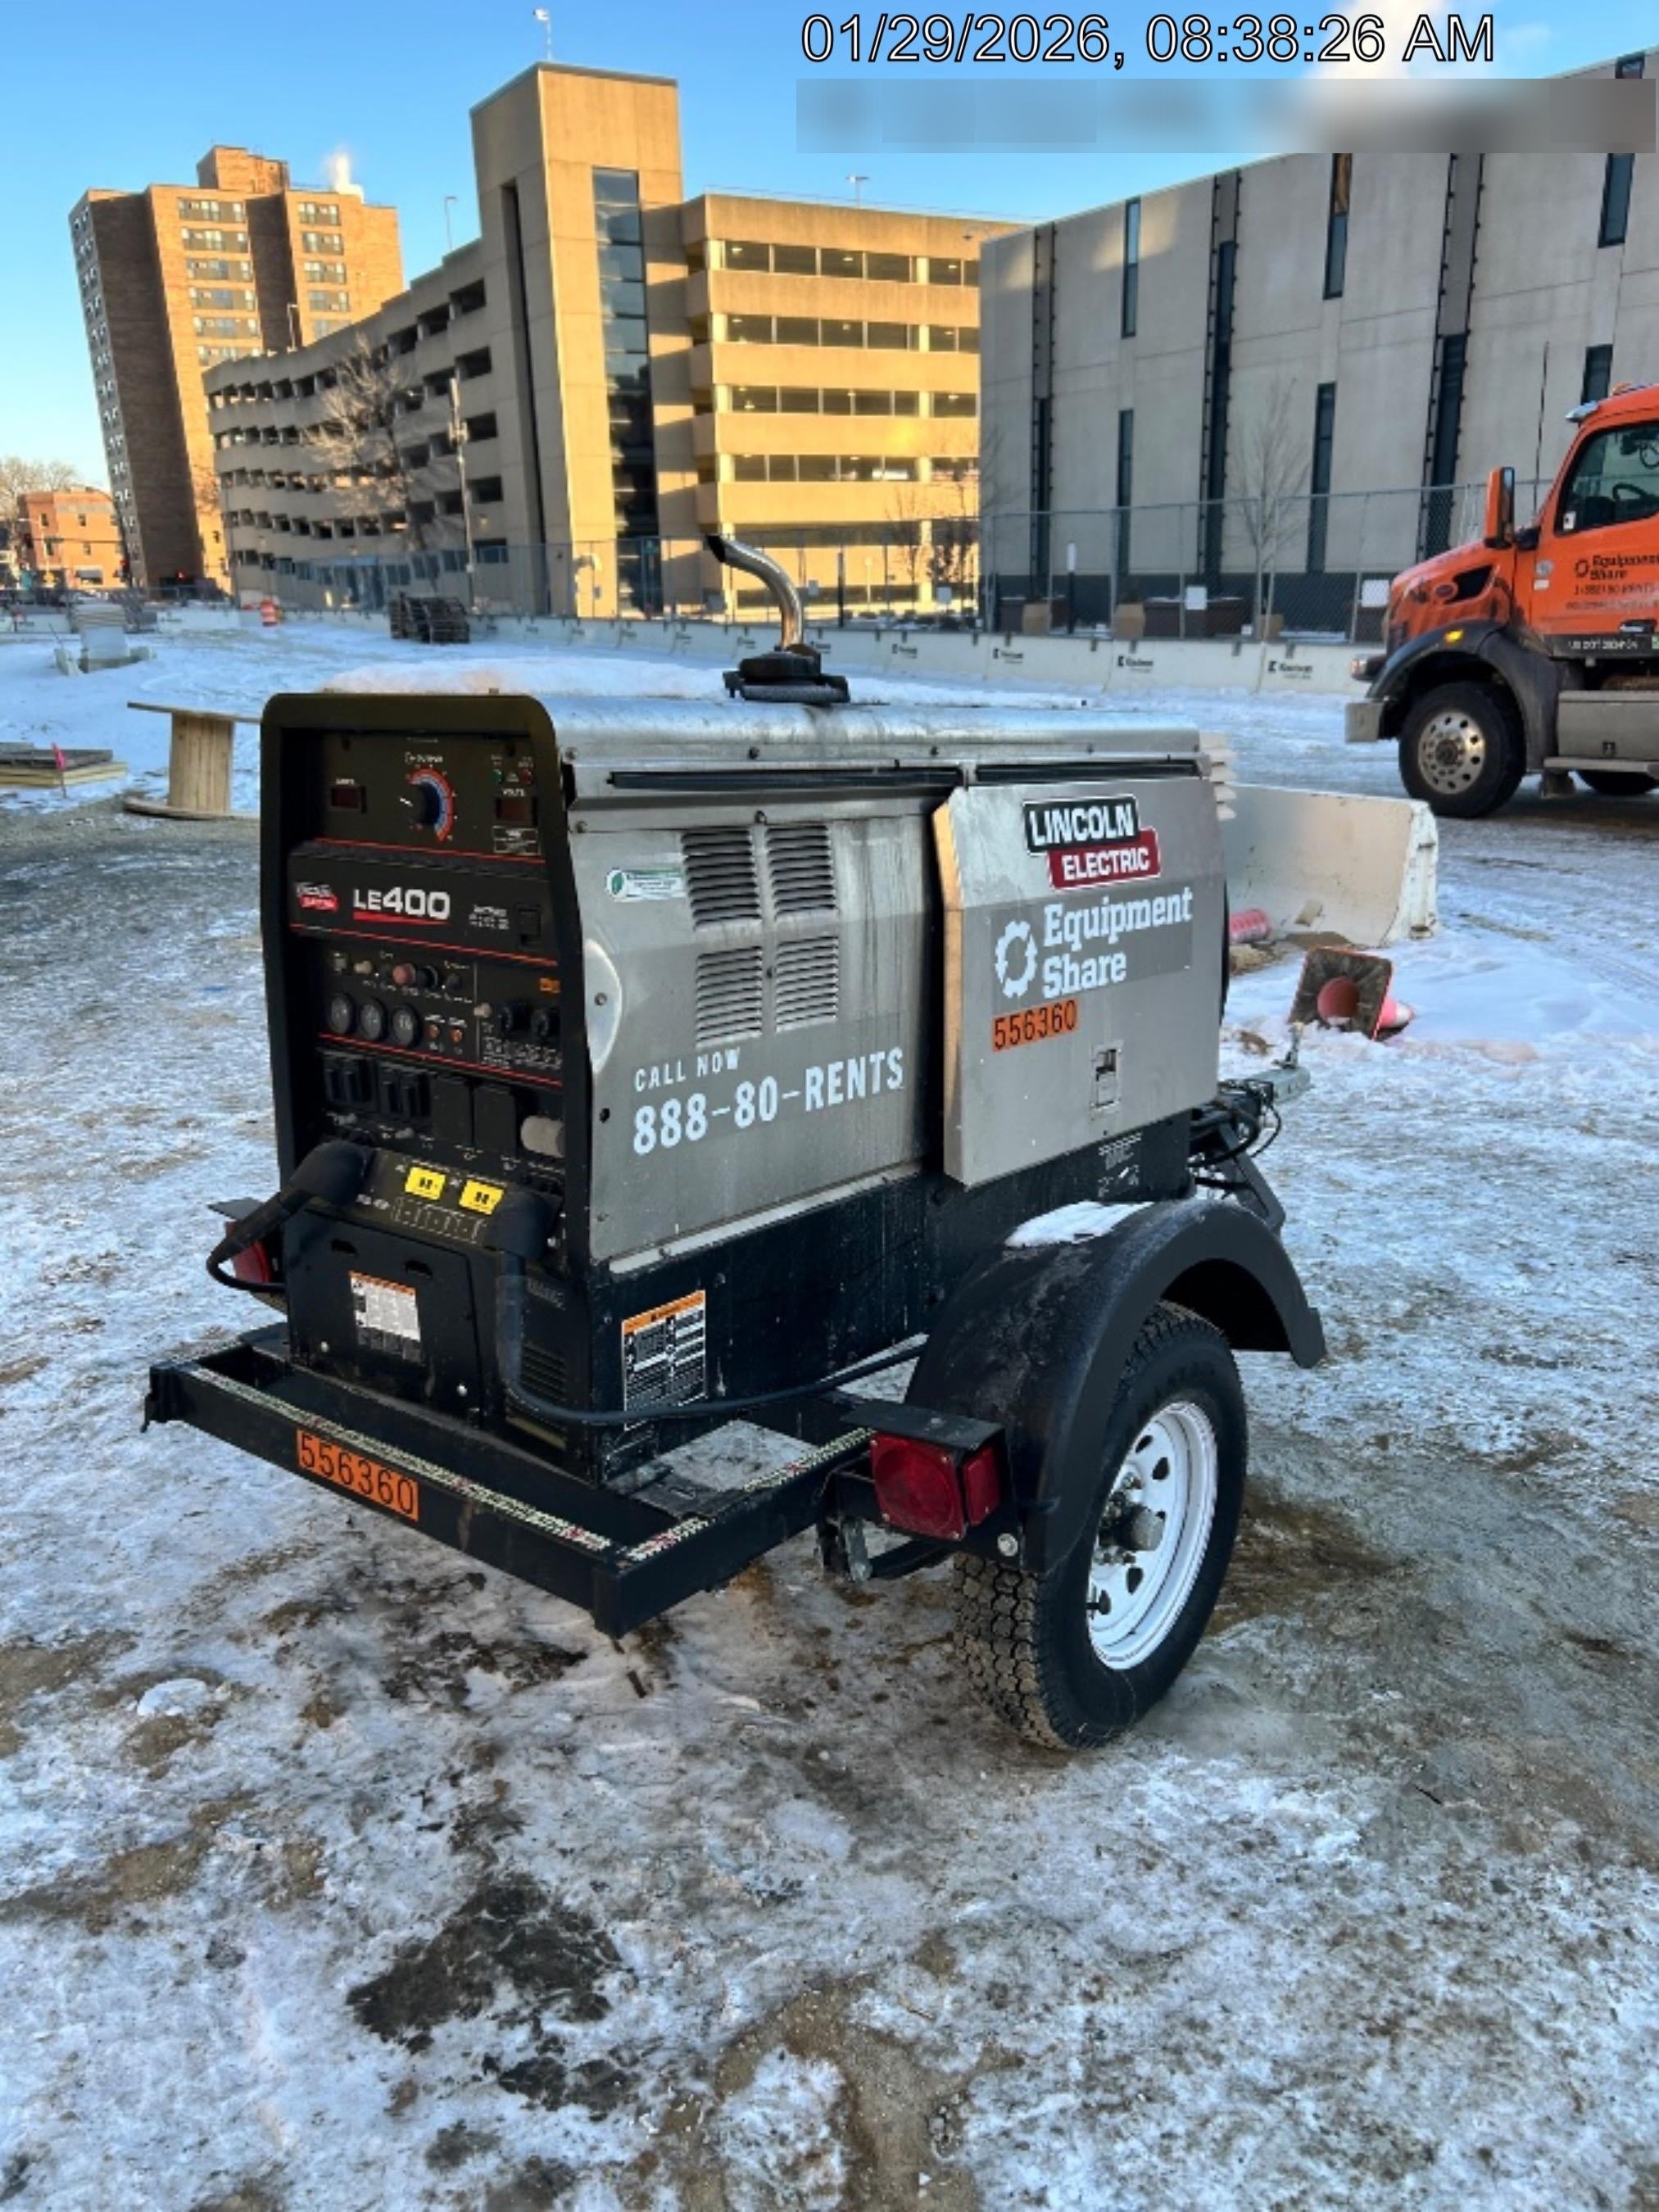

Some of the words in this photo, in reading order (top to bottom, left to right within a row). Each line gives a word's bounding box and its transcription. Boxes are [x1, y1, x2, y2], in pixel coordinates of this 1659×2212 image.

[1029, 803, 1134, 845] LINCOLN
[1062, 847, 1149, 881] ELECTRIC
[352, 886, 451, 920] LE400
[1042, 886, 1193, 953] Equipment
[1041, 952, 1127, 999] Share
[993, 999, 1077, 1049] 556360
[634, 1059, 687, 1093] CALL
[696, 1046, 741, 1078] NOW
[632, 1046, 905, 1156] 888-80-RENTS
[300, 1434, 415, 1516] 556360
